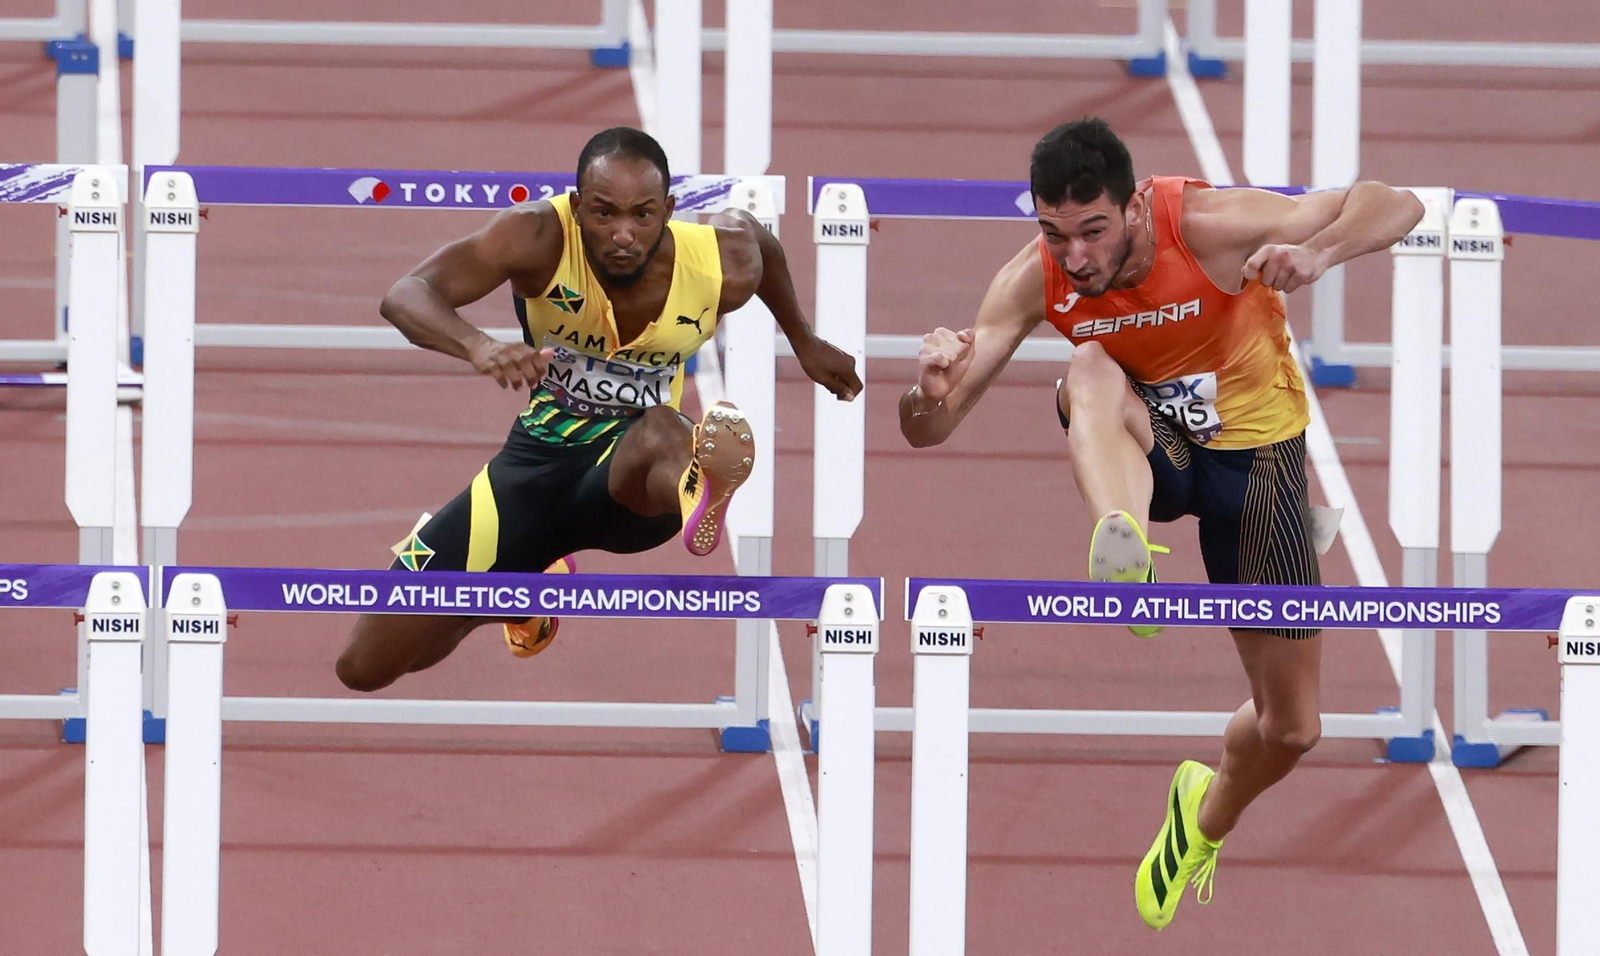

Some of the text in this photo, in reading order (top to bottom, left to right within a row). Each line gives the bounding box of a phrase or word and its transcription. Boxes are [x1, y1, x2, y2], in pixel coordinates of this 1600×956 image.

[74, 211, 117, 225] NISHI
[150, 212, 192, 225] NISHI
[821, 223, 863, 237] NISHI
[1400, 235, 1441, 247] NISHI
[1453, 240, 1495, 253] NISHI
[1071, 298, 1201, 338] ESPAÑA
[548, 324, 681, 366] JAMAICA
[548, 362, 662, 406] MASON
[1151, 378, 1204, 400] DK
[282, 583, 761, 613] WORLD ATHLETICS CHAMPIONSHIPS
[1027, 595, 1502, 624] WORLD ATHLETICS CHAMPIONSHIPS
[92, 618, 139, 633] NISHI
[172, 619, 219, 634] NISHI
[825, 630, 872, 645] NISHI
[919, 632, 966, 647] NISHI
[1566, 641, 1600, 656] NIS
